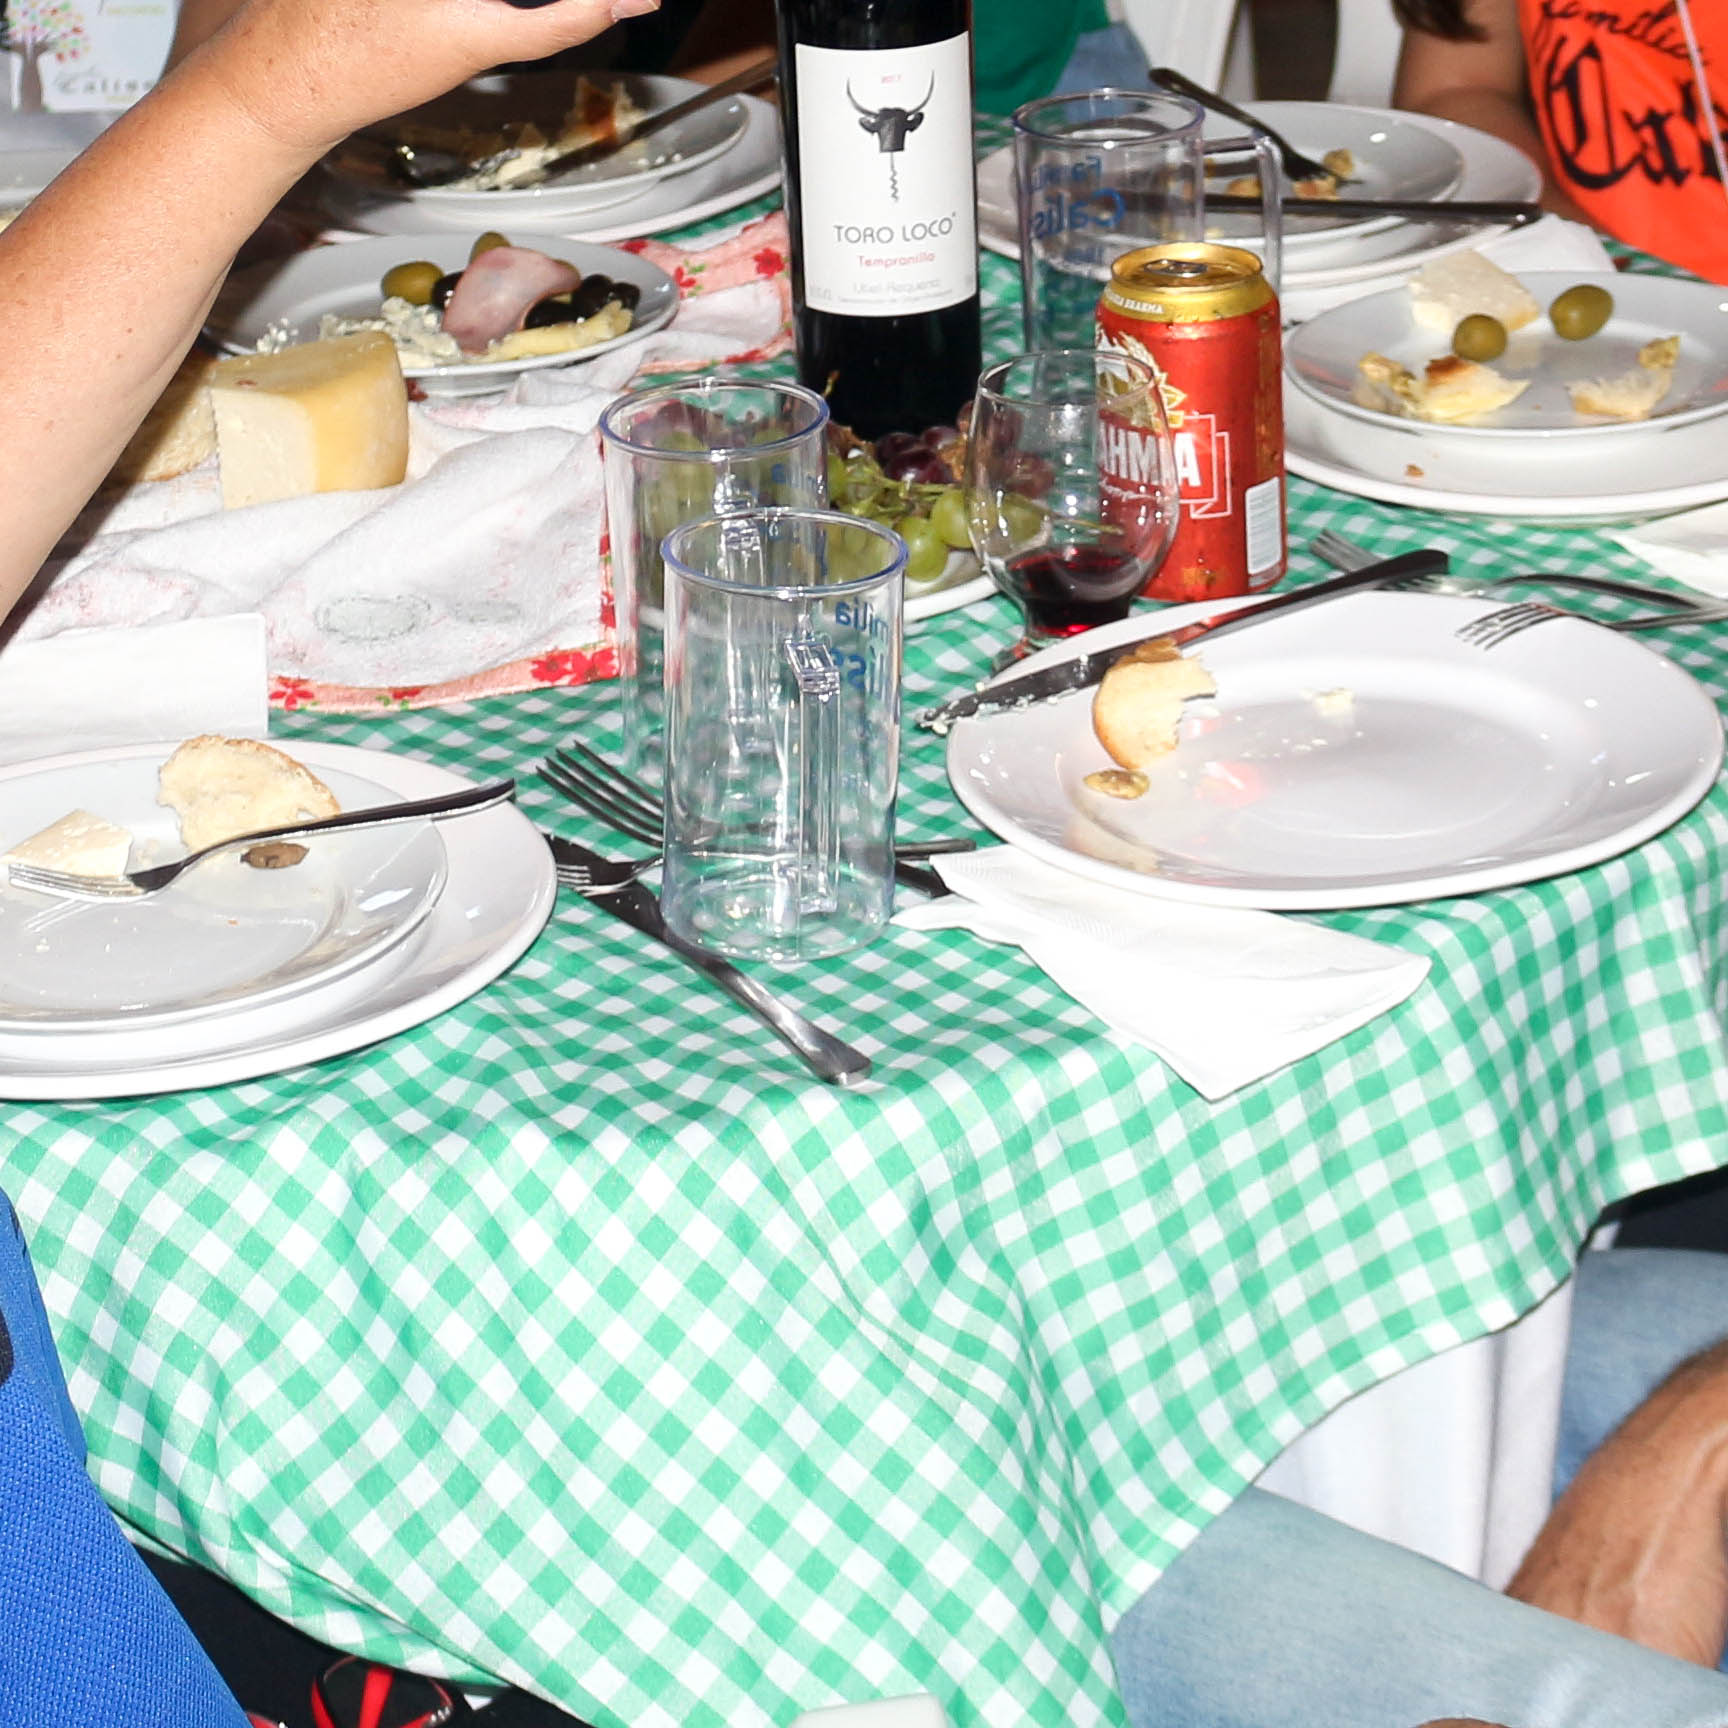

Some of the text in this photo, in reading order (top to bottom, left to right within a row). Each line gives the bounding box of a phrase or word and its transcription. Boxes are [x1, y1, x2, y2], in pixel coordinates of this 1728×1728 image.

[833, 217, 954, 245] TORO LOCO
[857, 251, 937, 270] Tempranillo
